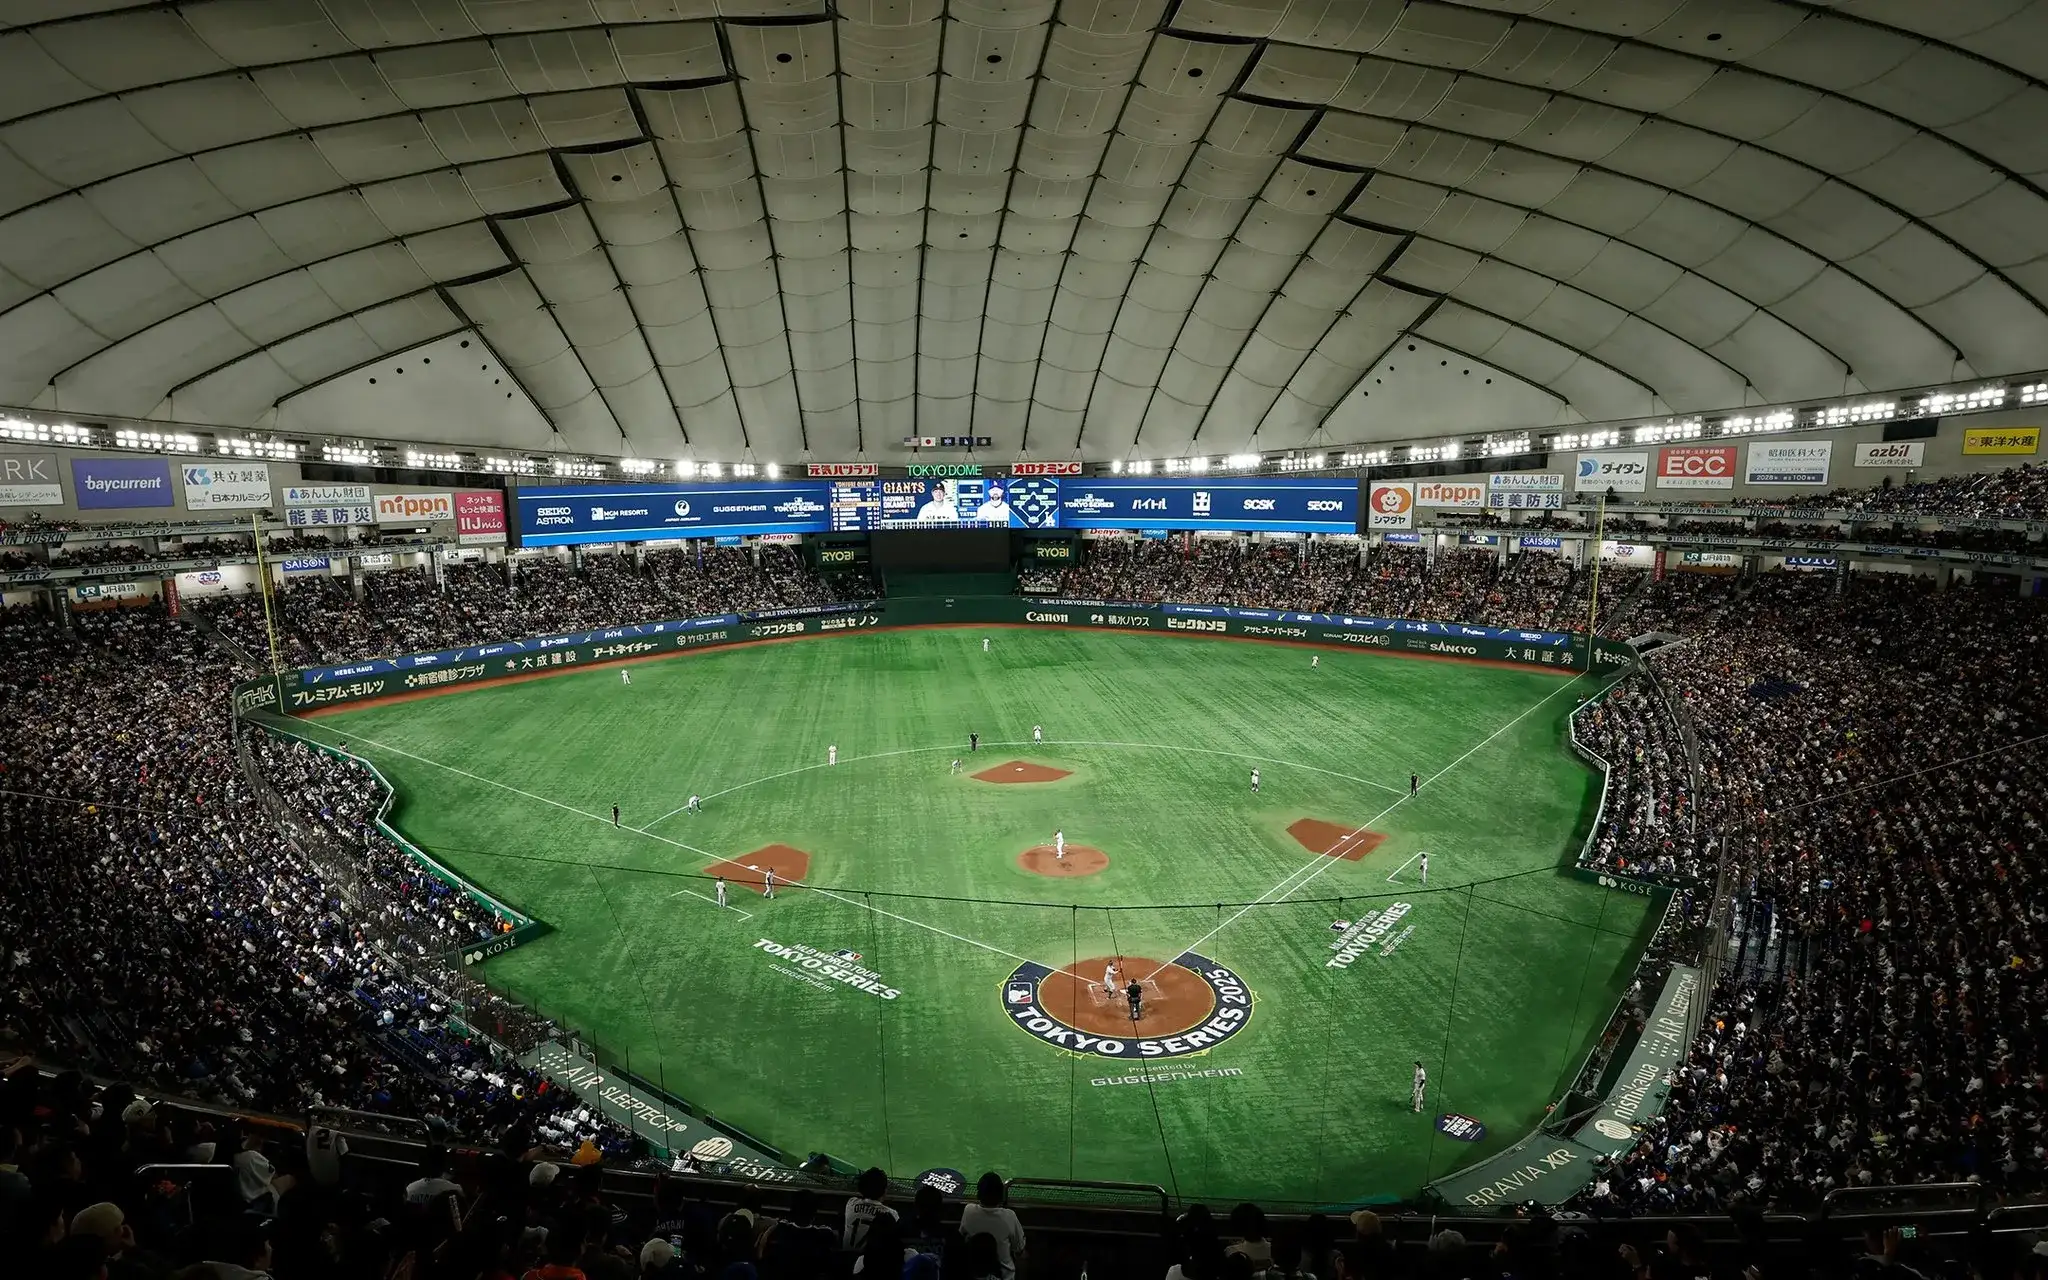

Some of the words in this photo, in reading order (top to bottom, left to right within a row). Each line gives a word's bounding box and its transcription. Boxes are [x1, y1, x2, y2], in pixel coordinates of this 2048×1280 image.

[1980, 435, 2033, 446] 東洋水産
[1869, 444, 1910, 457] azbil
[0, 459, 49, 480] RK
[905, 464, 947, 477] TOKYO
[948, 464, 983, 477] DOME
[1013, 462, 1081, 474] オロナミンC
[1602, 461, 1645, 475] ダイダン
[1666, 455, 1726, 475] ECC
[212, 470, 268, 482] 共立製薬
[1502, 475, 1560, 485] あんしん財団
[85, 475, 162, 492] baycurrent
[883, 481, 926, 494] GIANTS
[211, 492, 270, 503] 日本カルミック
[299, 487, 365, 499] あんしん財団
[1420, 483, 1480, 502] nippn
[380, 495, 449, 517] nippn
[466, 496, 493, 504] ネットを
[1243, 499, 1276, 510] SCSK
[1307, 500, 1343, 511] SECOM
[1490, 493, 1560, 508] 能美防災
[537, 507, 572, 516] SEIKO
[620, 509, 649, 517] RESORTS
[713, 504, 768, 512] GUGGENHEIM
[1749, 509, 1786, 518] DUSKIN
[1789, 510, 1826, 520] DUSKIN
[288, 507, 371, 526] 能美防災
[460, 516, 503, 530] IIJmio
[535, 516, 574, 525] ASTRON
[1374, 515, 1406, 525] シマダヤ
[762, 533, 793, 541] Denyo
[1090, 528, 1120, 536] Denyo
[1523, 537, 1558, 546] SAISON
[821, 551, 855, 562] RYOBI
[1037, 547, 1069, 558] RYOBI
[1686, 552, 1700, 560] JR
[285, 559, 327, 570] SAISON
[80, 586, 97, 597] JR
[777, 608, 799, 616] TOKYO
[1025, 611, 1069, 623] Canon
[1107, 615, 1150, 627] 積水ハウス
[1167, 617, 1228, 632] ビックカメラ
[761, 621, 805, 635] フコク生命
[1243, 625, 1307, 638] アサヒスーパードライ
[592, 642, 659, 658] アートネイチャー
[1430, 640, 1477, 655] SANKYO
[521, 650, 577, 669] 大成建設
[1504, 647, 1575, 665] 大和証券
[334, 668, 355, 676] HEBEL
[356, 665, 373, 673] HAUS
[417, 663, 486, 686] 新宿健診プラザ
[242, 684, 275, 707] THK
[291, 680, 385, 706] プレミアム・モルツ
[1620, 881, 1653, 895] KOSÉ
[1325, 933, 1377, 969] TOKYO
[1365, 901, 1412, 935] SERIES
[486, 935, 517, 957] KOSÉ
[752, 938, 823, 969] TOKYO
[817, 964, 901, 1000] SERIES
[816, 951, 852, 969] WORLD
[850, 964, 882, 979] TOUR
[768, 963, 835, 993] GUGGENHEIM
[1015, 1005, 1125, 1054] TOKYO
[1138, 1007, 1244, 1056] SERIES
[1205, 969, 1247, 1004] 2025
[1128, 1063, 1183, 1073] Presented
[1091, 1067, 1244, 1087] GUGGENHEIM
[1613, 1062, 1660, 1120] nishikawa
[1464, 1164, 1548, 1208] BRAVIA
[1539, 1147, 1580, 1171] XR
